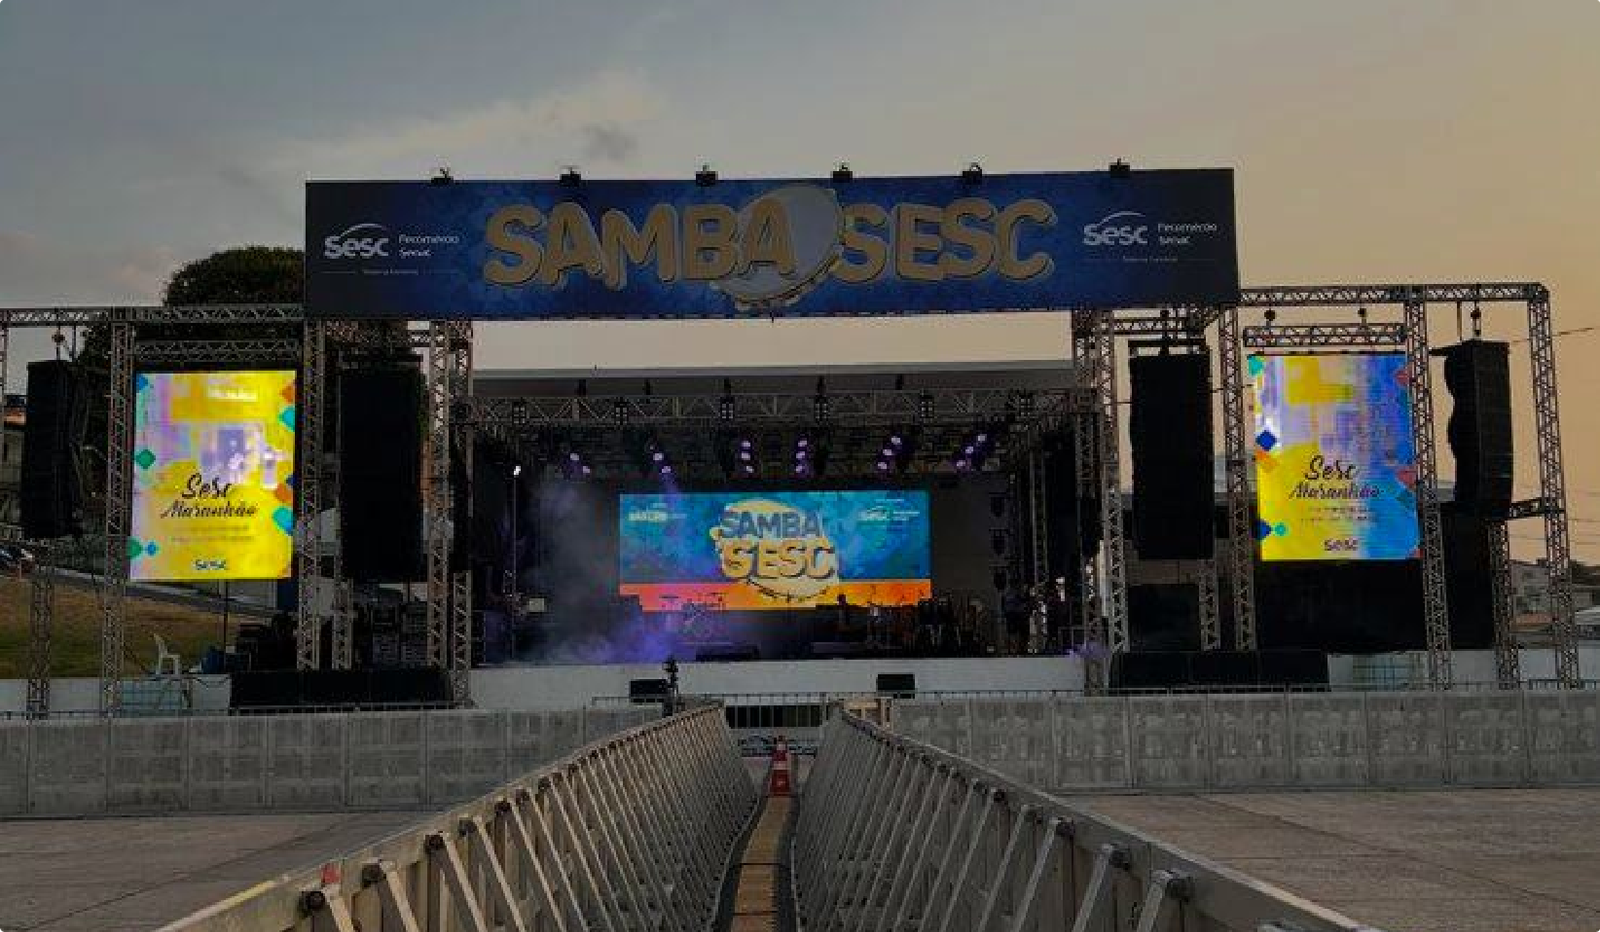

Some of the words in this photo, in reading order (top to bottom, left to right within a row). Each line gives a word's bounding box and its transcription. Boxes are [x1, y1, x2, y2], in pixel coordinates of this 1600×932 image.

[483, 201, 797, 287] SAMBA
[834, 198, 1057, 283] SESC
[1305, 454, 1357, 480] Sesc
[182, 472, 231, 499] Sesc
[719, 510, 822, 538] SAMBA
[721, 537, 834, 580] SESC
